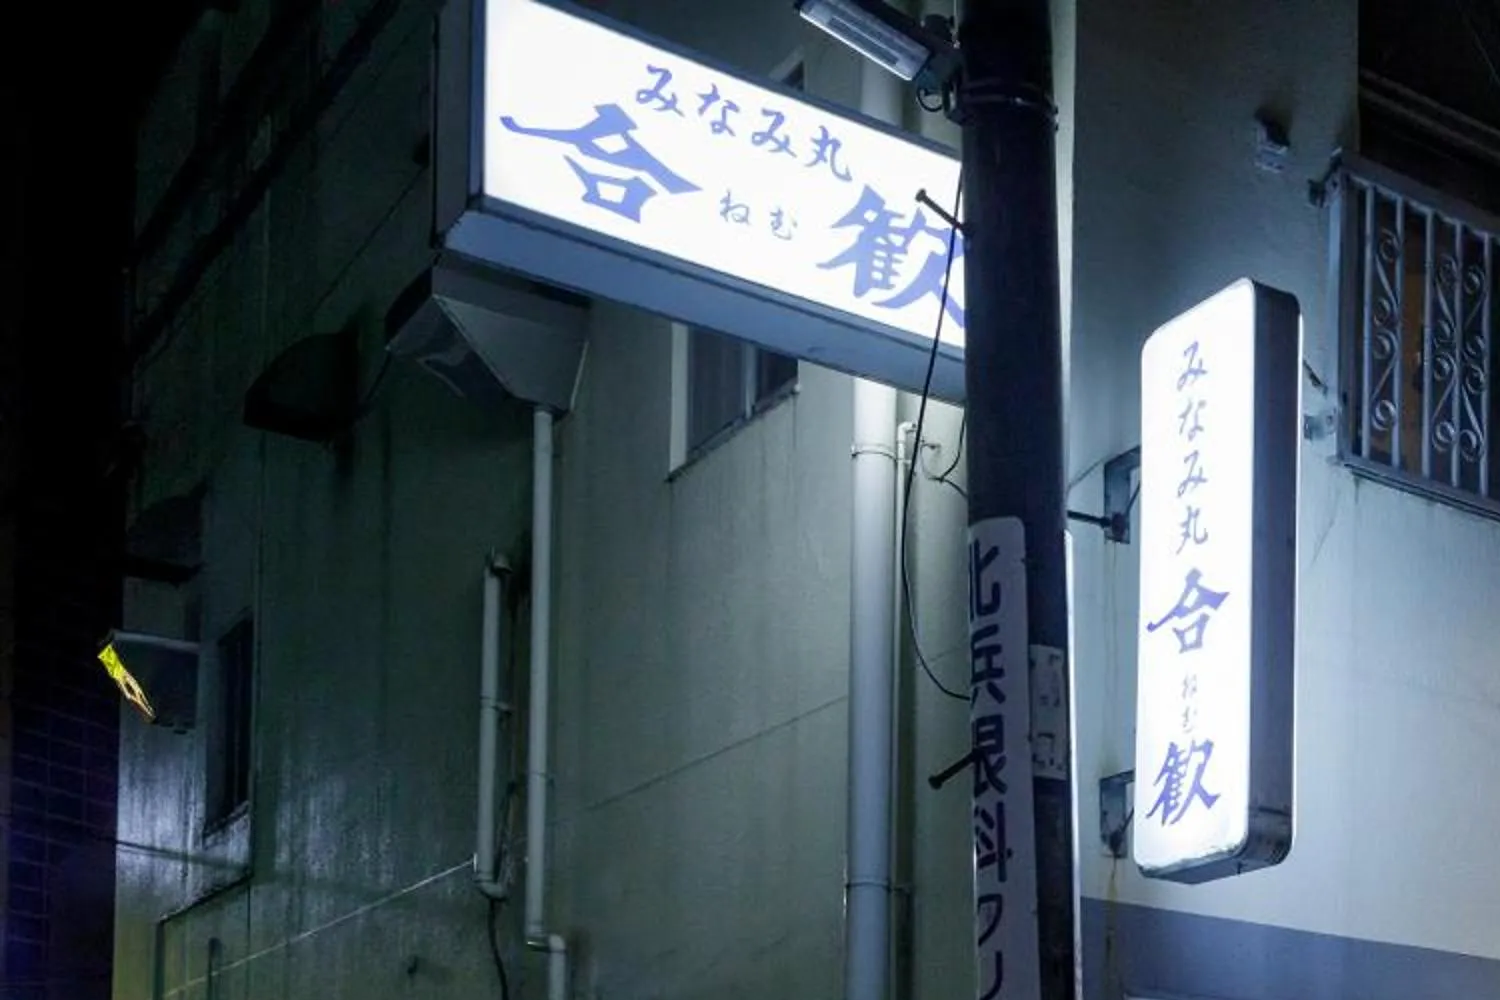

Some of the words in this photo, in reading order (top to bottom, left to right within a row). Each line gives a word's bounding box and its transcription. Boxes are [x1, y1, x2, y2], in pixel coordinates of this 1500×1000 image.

[635, 64, 853, 182] みなみ丸
[500, 104, 704, 223] 合
[816, 184, 965, 328] 歓
[719, 190, 798, 241] ねむ
[1176, 340, 1211, 554] みなみ丸
[1147, 568, 1230, 653] 合
[1146, 740, 1221, 826] 歓
